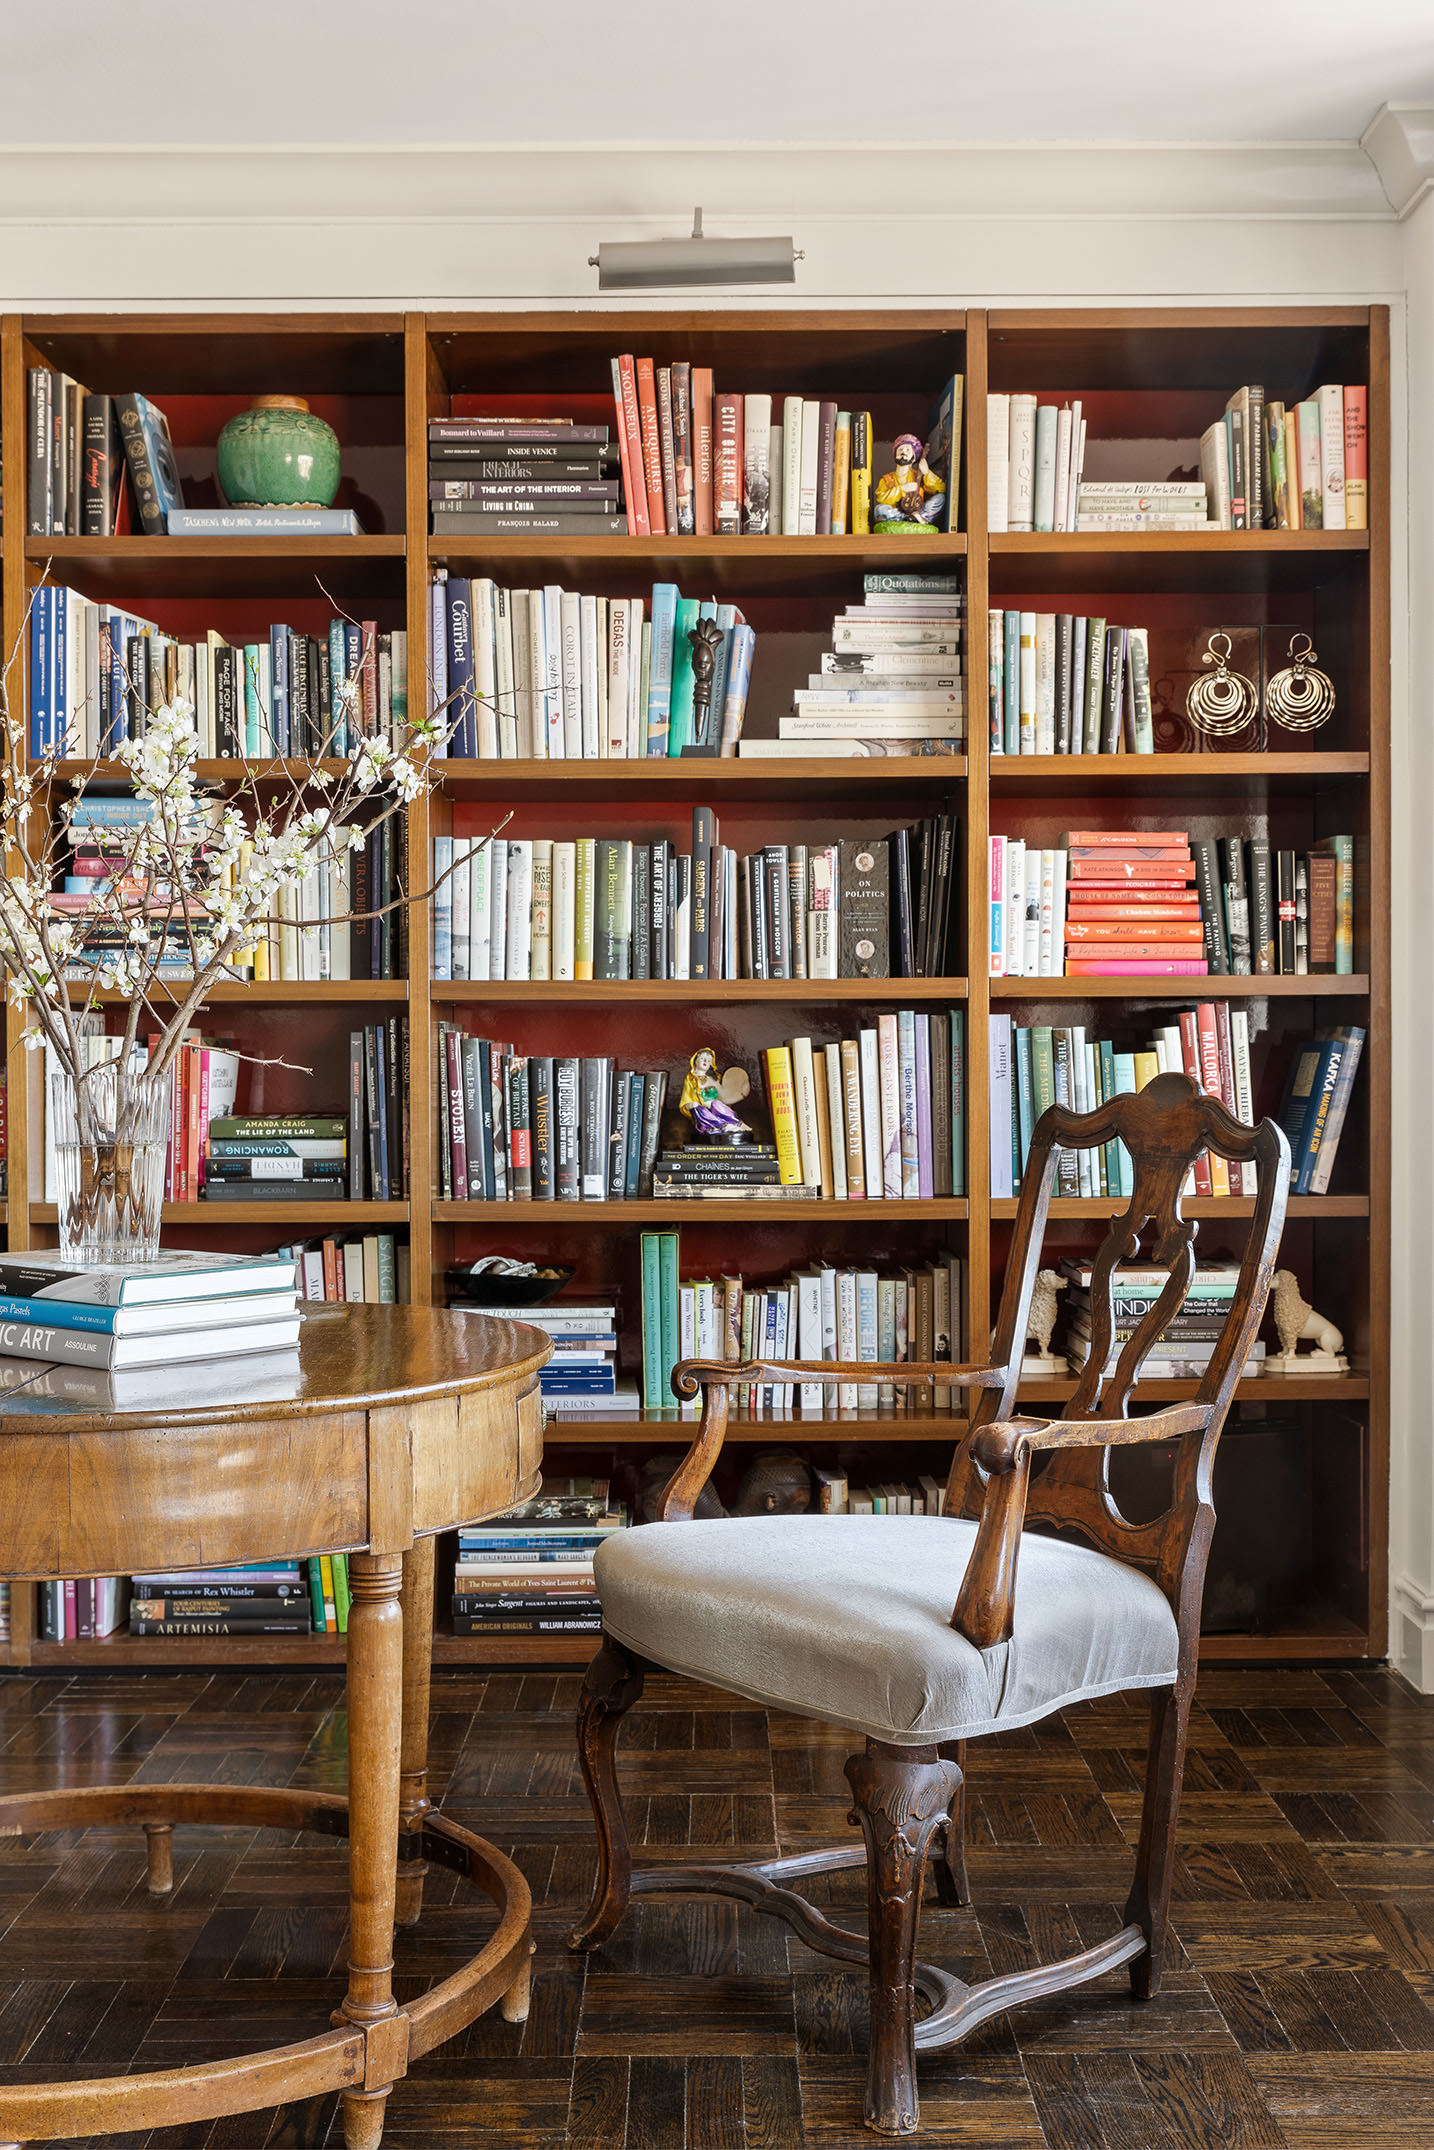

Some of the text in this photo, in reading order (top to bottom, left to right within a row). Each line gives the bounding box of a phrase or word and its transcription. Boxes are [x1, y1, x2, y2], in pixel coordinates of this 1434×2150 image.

[621, 369, 637, 440] MOLYNEUX
[440, 429, 469, 437] Bonnard
[477, 429, 505, 437] Vuillard
[659, 371, 673, 481] ROOMS TO REMEMBER
[646, 405, 662, 493] ANTIQUAIRES
[721, 406, 736, 485] CITY ON FIRE
[482, 469, 533, 478] INTERIORS
[482, 500, 535, 511] LIVING IN CHINA
[497, 520, 530, 528] FRANÇOIS
[882, 577, 940, 589] Quotations
[451, 600, 467, 664] Courbet
[613, 611, 624, 648] DEGAS
[565, 625, 578, 721] COROT IN ITALY
[1090, 636, 1102, 680] FACEMAKER
[321, 656, 330, 703] Kazuo Ishiguro
[223, 711, 231, 737] FAME
[356, 855, 366, 885] VERA
[608, 846, 618, 910] Alan Bennett
[640, 871, 648, 901] Howard:
[695, 860, 705, 899] SARGENT
[1201, 847, 1212, 901] SARAH WATERS
[1343, 844, 1352, 893] SUE MILLER
[654, 845, 663, 928] THE ART OF FORGERY
[640, 903, 648, 927] Portrait
[695, 908, 705, 933] PARIS
[1257, 861, 1268, 952] THE KING'S PAINTER
[640, 943, 648, 967] Failure
[1213, 929, 1221, 956] PAYING
[466, 1053, 475, 1076] VIGÉE
[1202, 1031, 1218, 1093] MALLORCA
[1322, 1052, 1342, 1092] KAFKA
[521, 1076, 529, 1119] THE FACE
[558, 1067, 575, 1126] GUY BURGESS
[954, 1045, 962, 1116] artists' houses
[466, 1087, 475, 1110] BRUN
[513, 1077, 521, 1128] OF BRITAIN
[616, 1080, 625, 1129] How to be both
[905, 1068, 915, 1137] Berthe Morisot
[451, 1089, 464, 1144] STOLEN
[537, 1094, 550, 1153] Whistler
[1310, 1092, 1331, 1153] MAKING OF AN ICON
[225, 1146, 289, 1154] ROMANCING
[519, 1131, 527, 1165] SCHAMA
[615, 1143, 624, 1175] Ali Smith
[684, 1293, 692, 1313] Funny
[698, 1288, 707, 1325] Everybody
[1121, 1287, 1144, 1295] home
[9, 1303, 31, 1316] Pastels
[727, 1290, 737, 1343] Orpheus
[19, 1328, 56, 1352] ART
[64, 1340, 97, 1352] ASSOULINE
[203, 1586, 255, 1597] Rex Whistler
[468, 1579, 579, 1588] The Private World of Yves Saint Laurent
[498, 1599, 524, 1612] Sargent
[156, 1624, 230, 1634] ARTEMISIA
[471, 1623, 533, 1631] AMERICAN ORIGINALS
[539, 1621, 601, 1629] WILLIAM ABRANOWICZ
